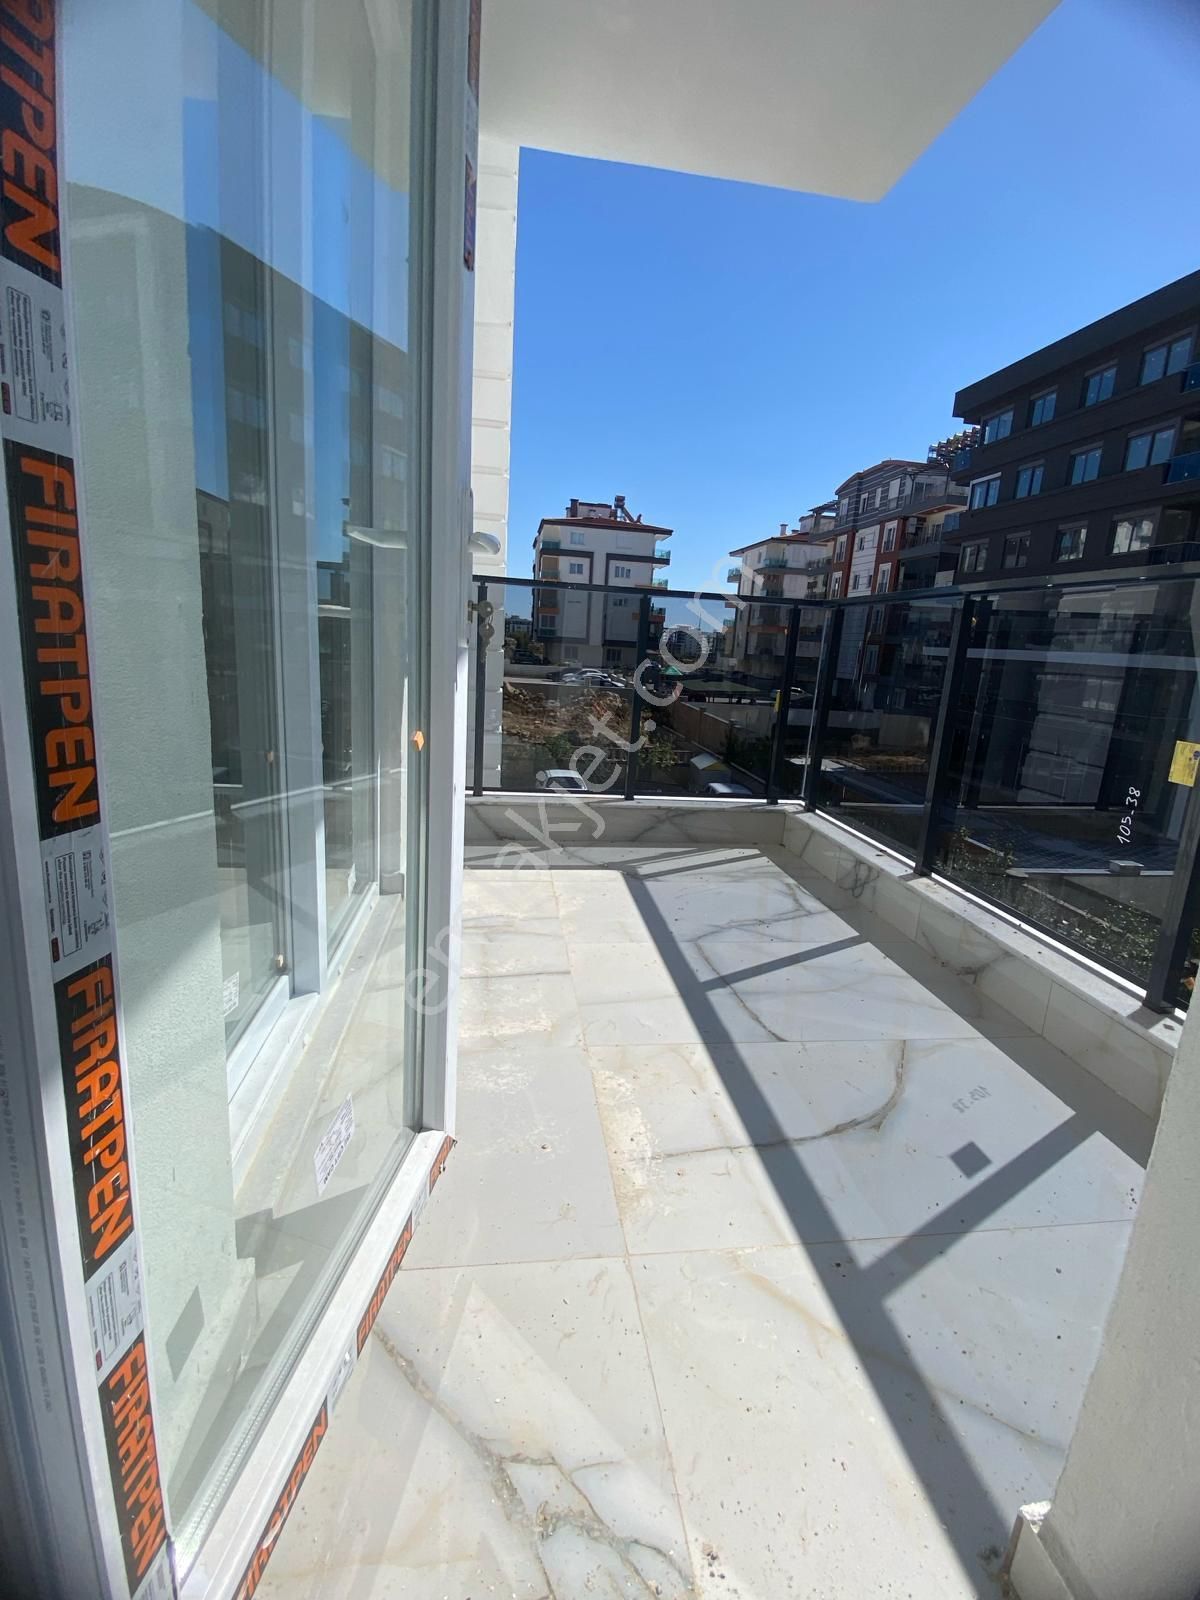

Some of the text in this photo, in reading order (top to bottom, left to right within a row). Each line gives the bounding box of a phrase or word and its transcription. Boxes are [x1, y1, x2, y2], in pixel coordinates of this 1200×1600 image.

[20, 456, 98, 823] FIRATPEN
[67, 966, 132, 1260] FIRATPEN
[109, 1341, 166, 1577] FIRATPEN
